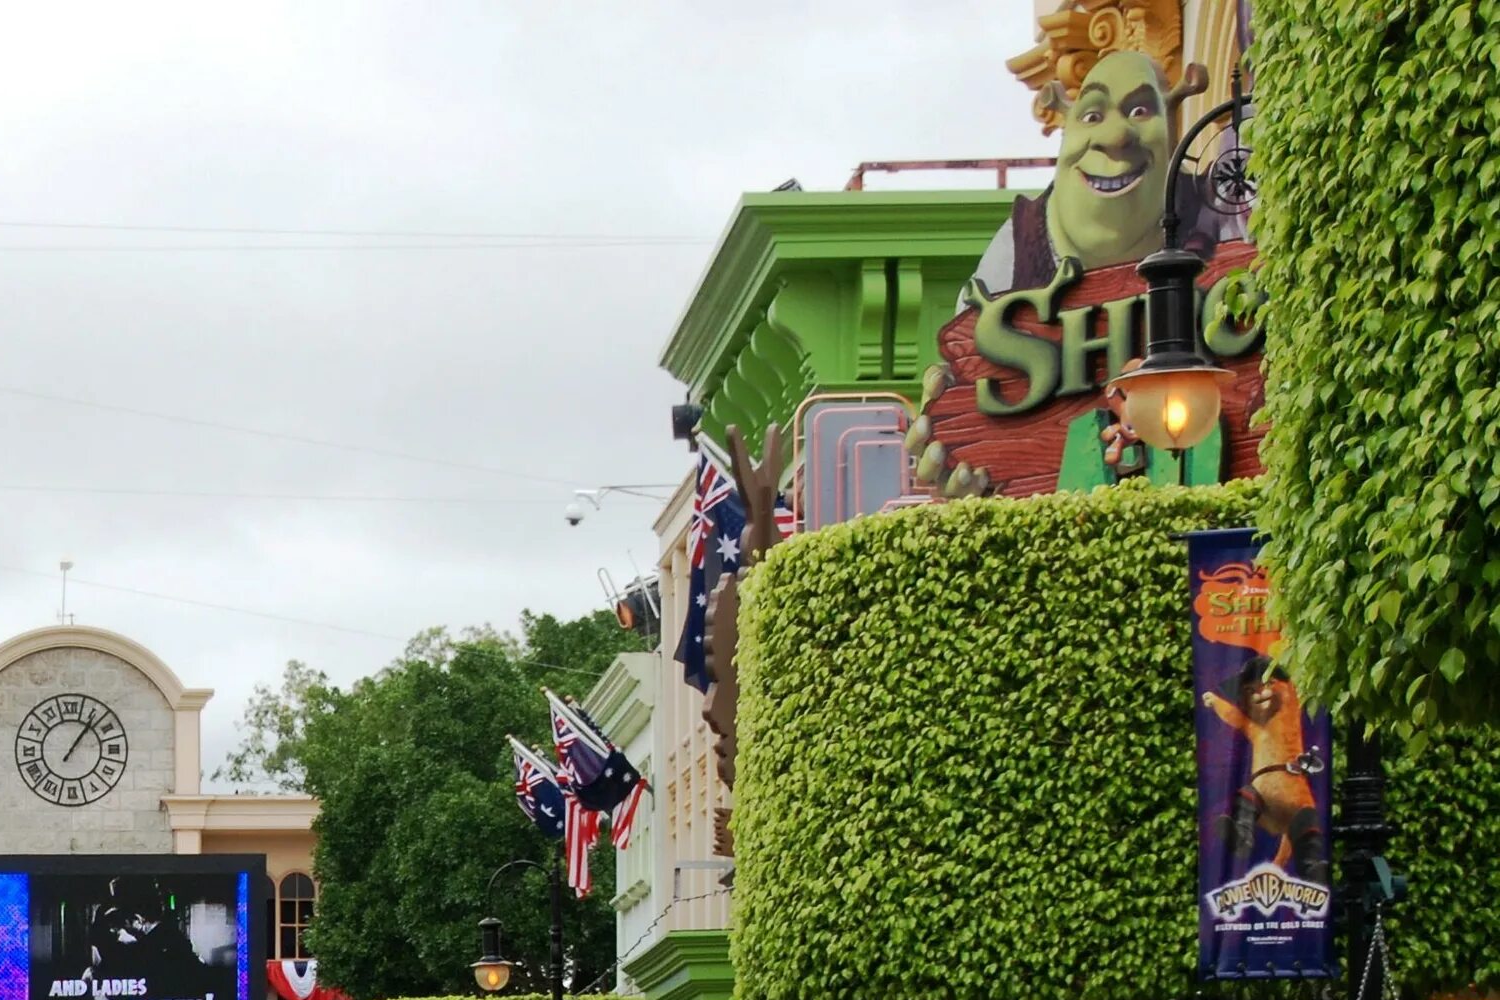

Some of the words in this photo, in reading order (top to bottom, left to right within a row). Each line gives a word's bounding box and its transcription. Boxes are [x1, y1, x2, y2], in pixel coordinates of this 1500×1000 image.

[1283, 882, 1327, 911] WORLD
[49, 980, 87, 996] AND
[92, 978, 147, 995] LADIES
